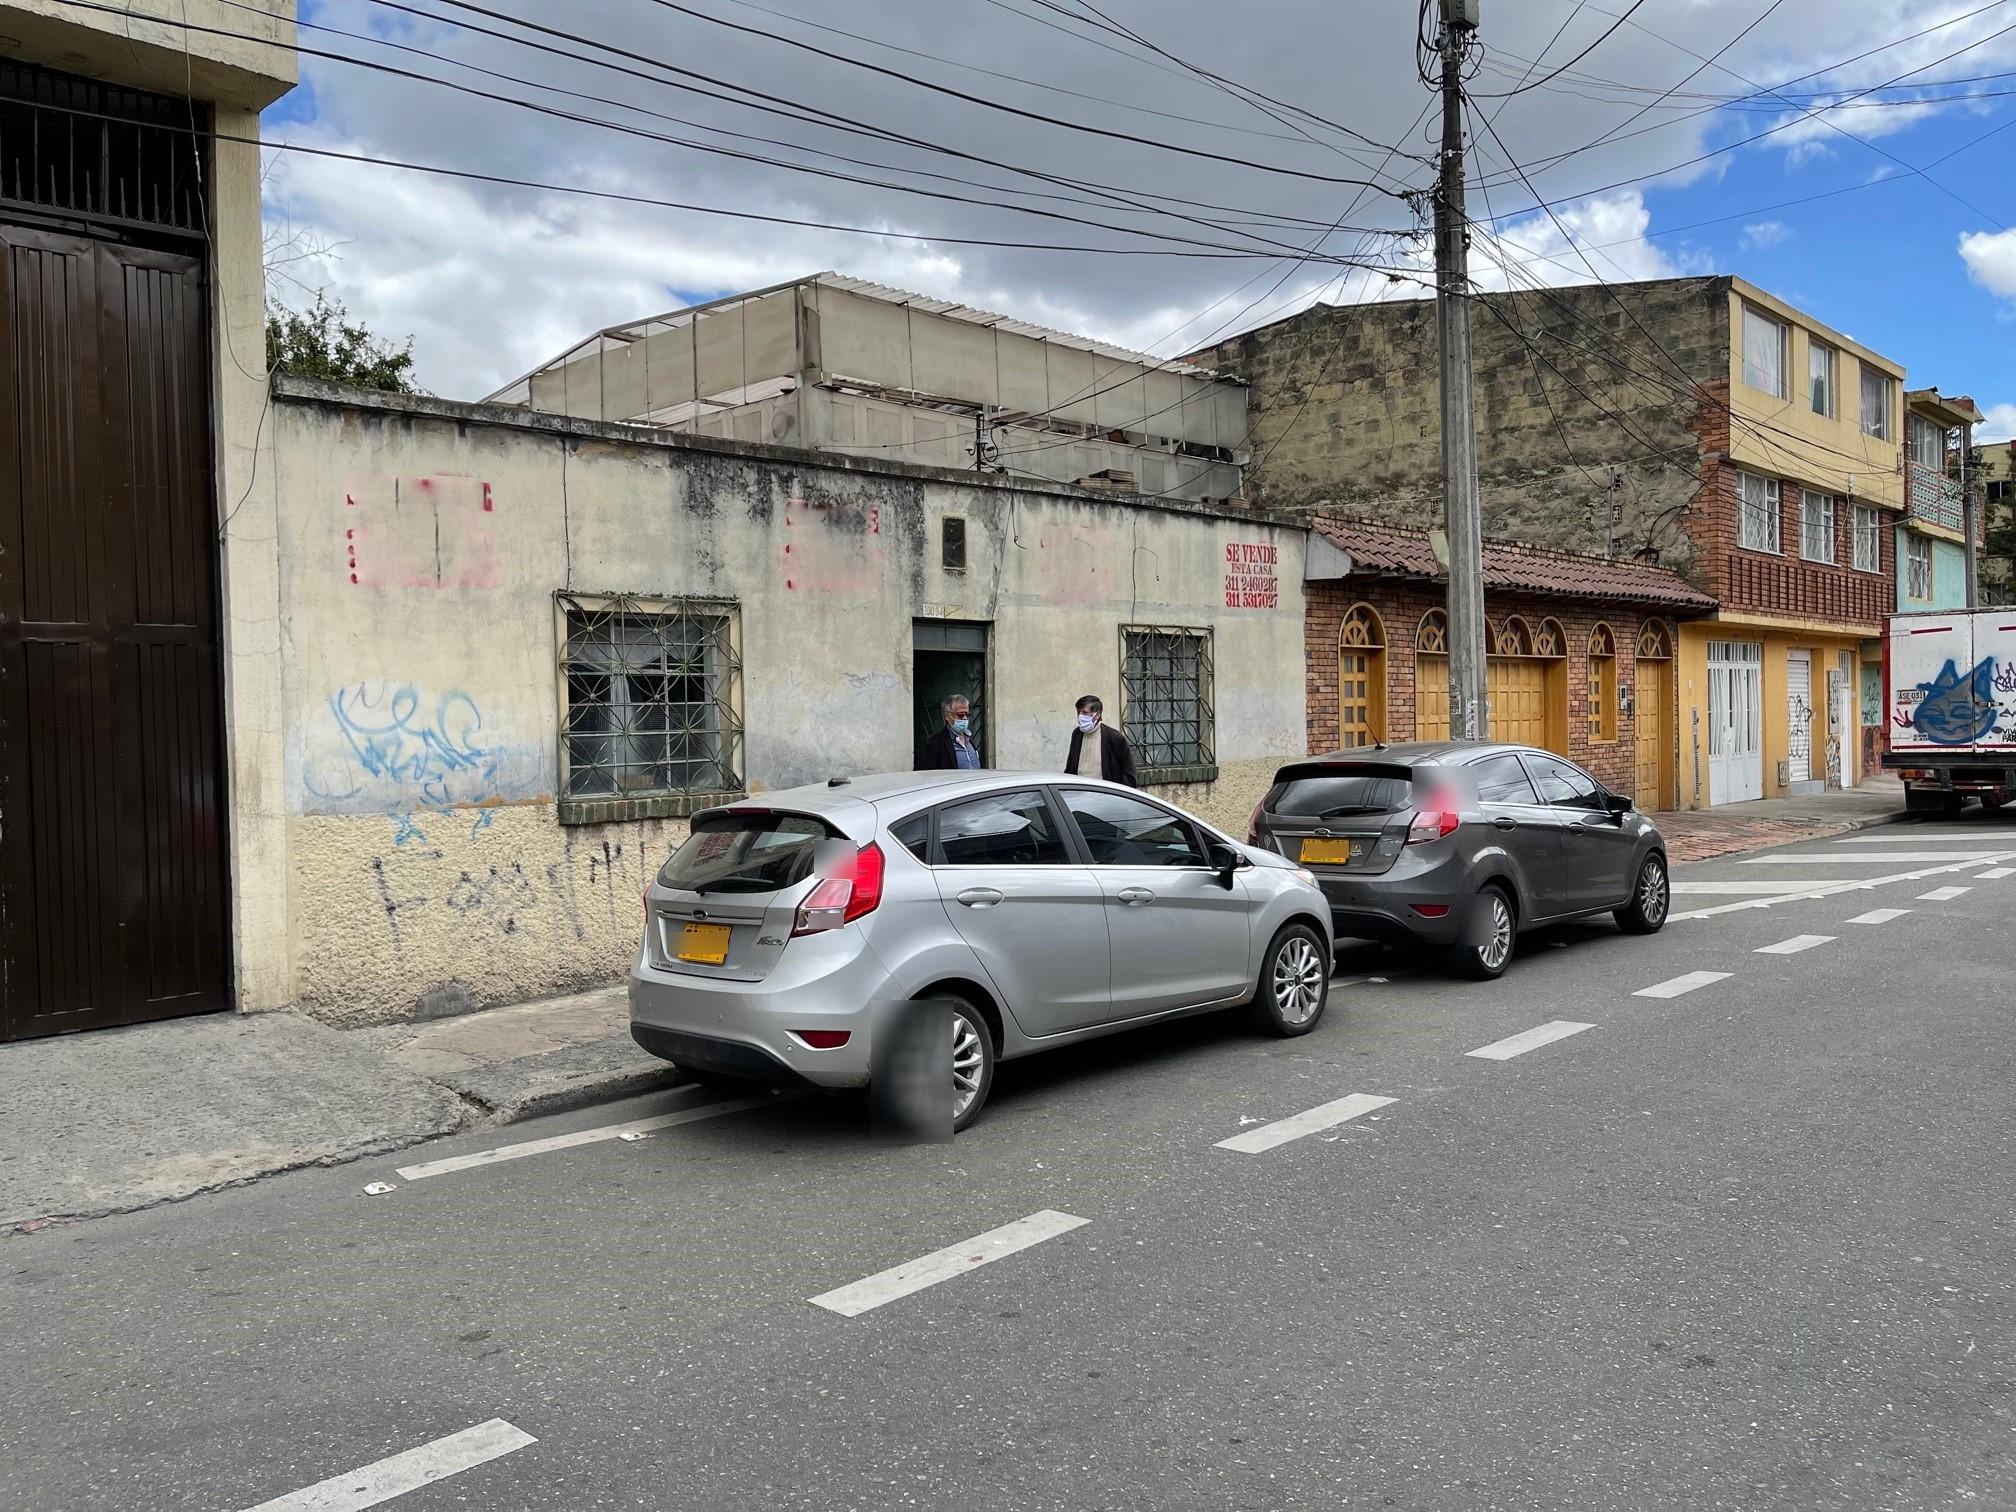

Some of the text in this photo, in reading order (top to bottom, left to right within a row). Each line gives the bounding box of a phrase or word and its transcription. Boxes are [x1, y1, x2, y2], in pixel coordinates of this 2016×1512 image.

[1226, 543, 1277, 564] SE VENDE
[1231, 563, 1272, 575] ESTA CASA
[1225, 575, 1239, 591] 311
[1226, 592, 1240, 608] 311
